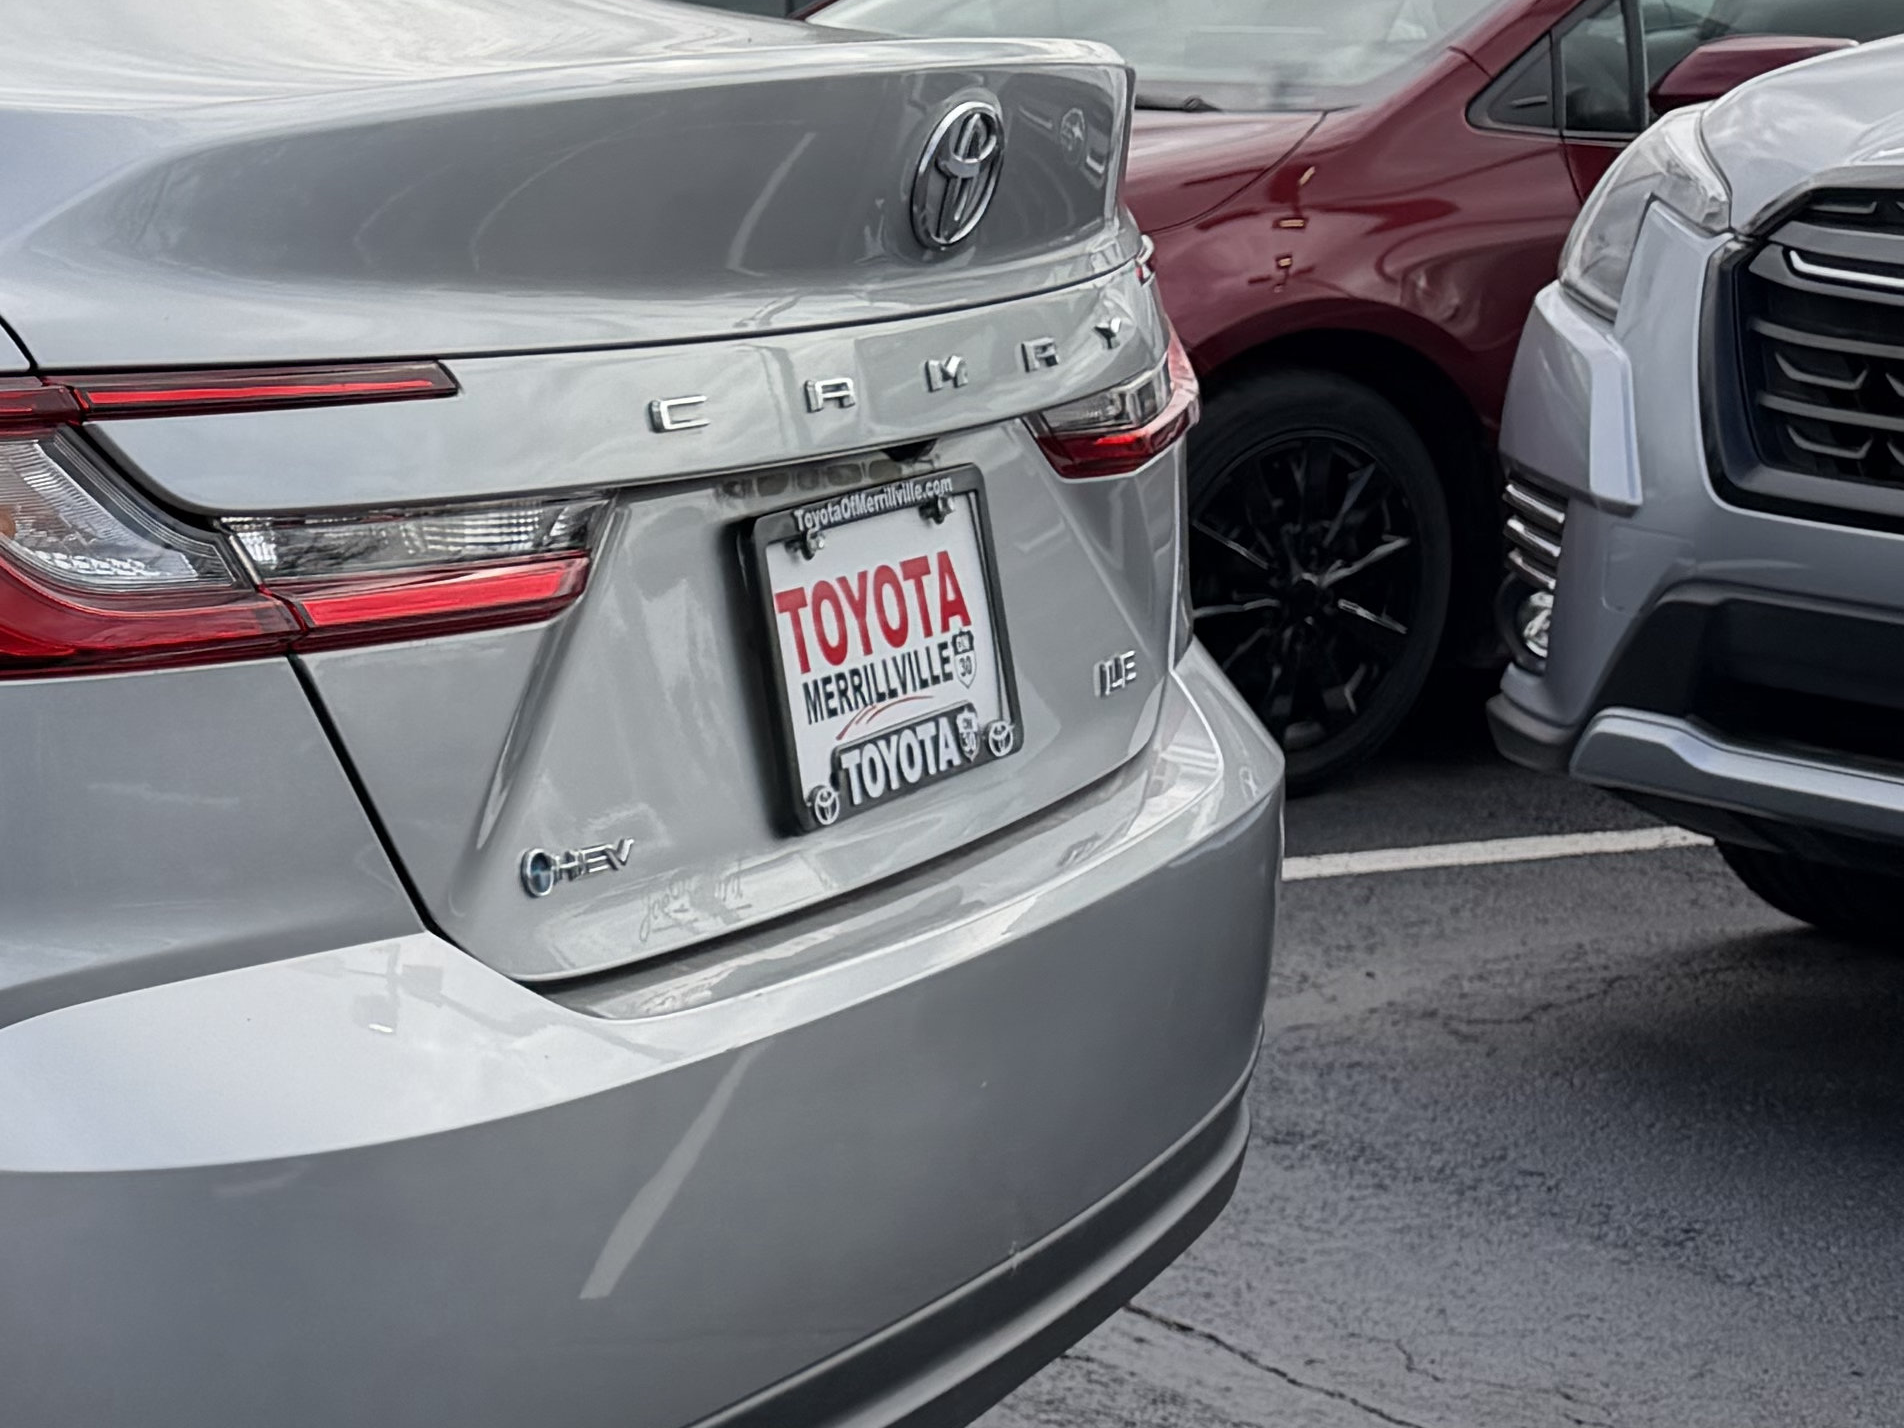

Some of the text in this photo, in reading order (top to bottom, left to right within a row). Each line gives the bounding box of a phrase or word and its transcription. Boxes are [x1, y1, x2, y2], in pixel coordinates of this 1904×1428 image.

[648, 317, 1122, 434] CAMRY
[794, 477, 953, 530] ToyotaOfMerrillville.com
[774, 550, 972, 675] TOYOTA
[802, 641, 972, 726] MERRILLVILLE 30
[1093, 650, 1137, 697] LE
[840, 716, 962, 806] TOYOTA
[551, 838, 635, 886] HEV
